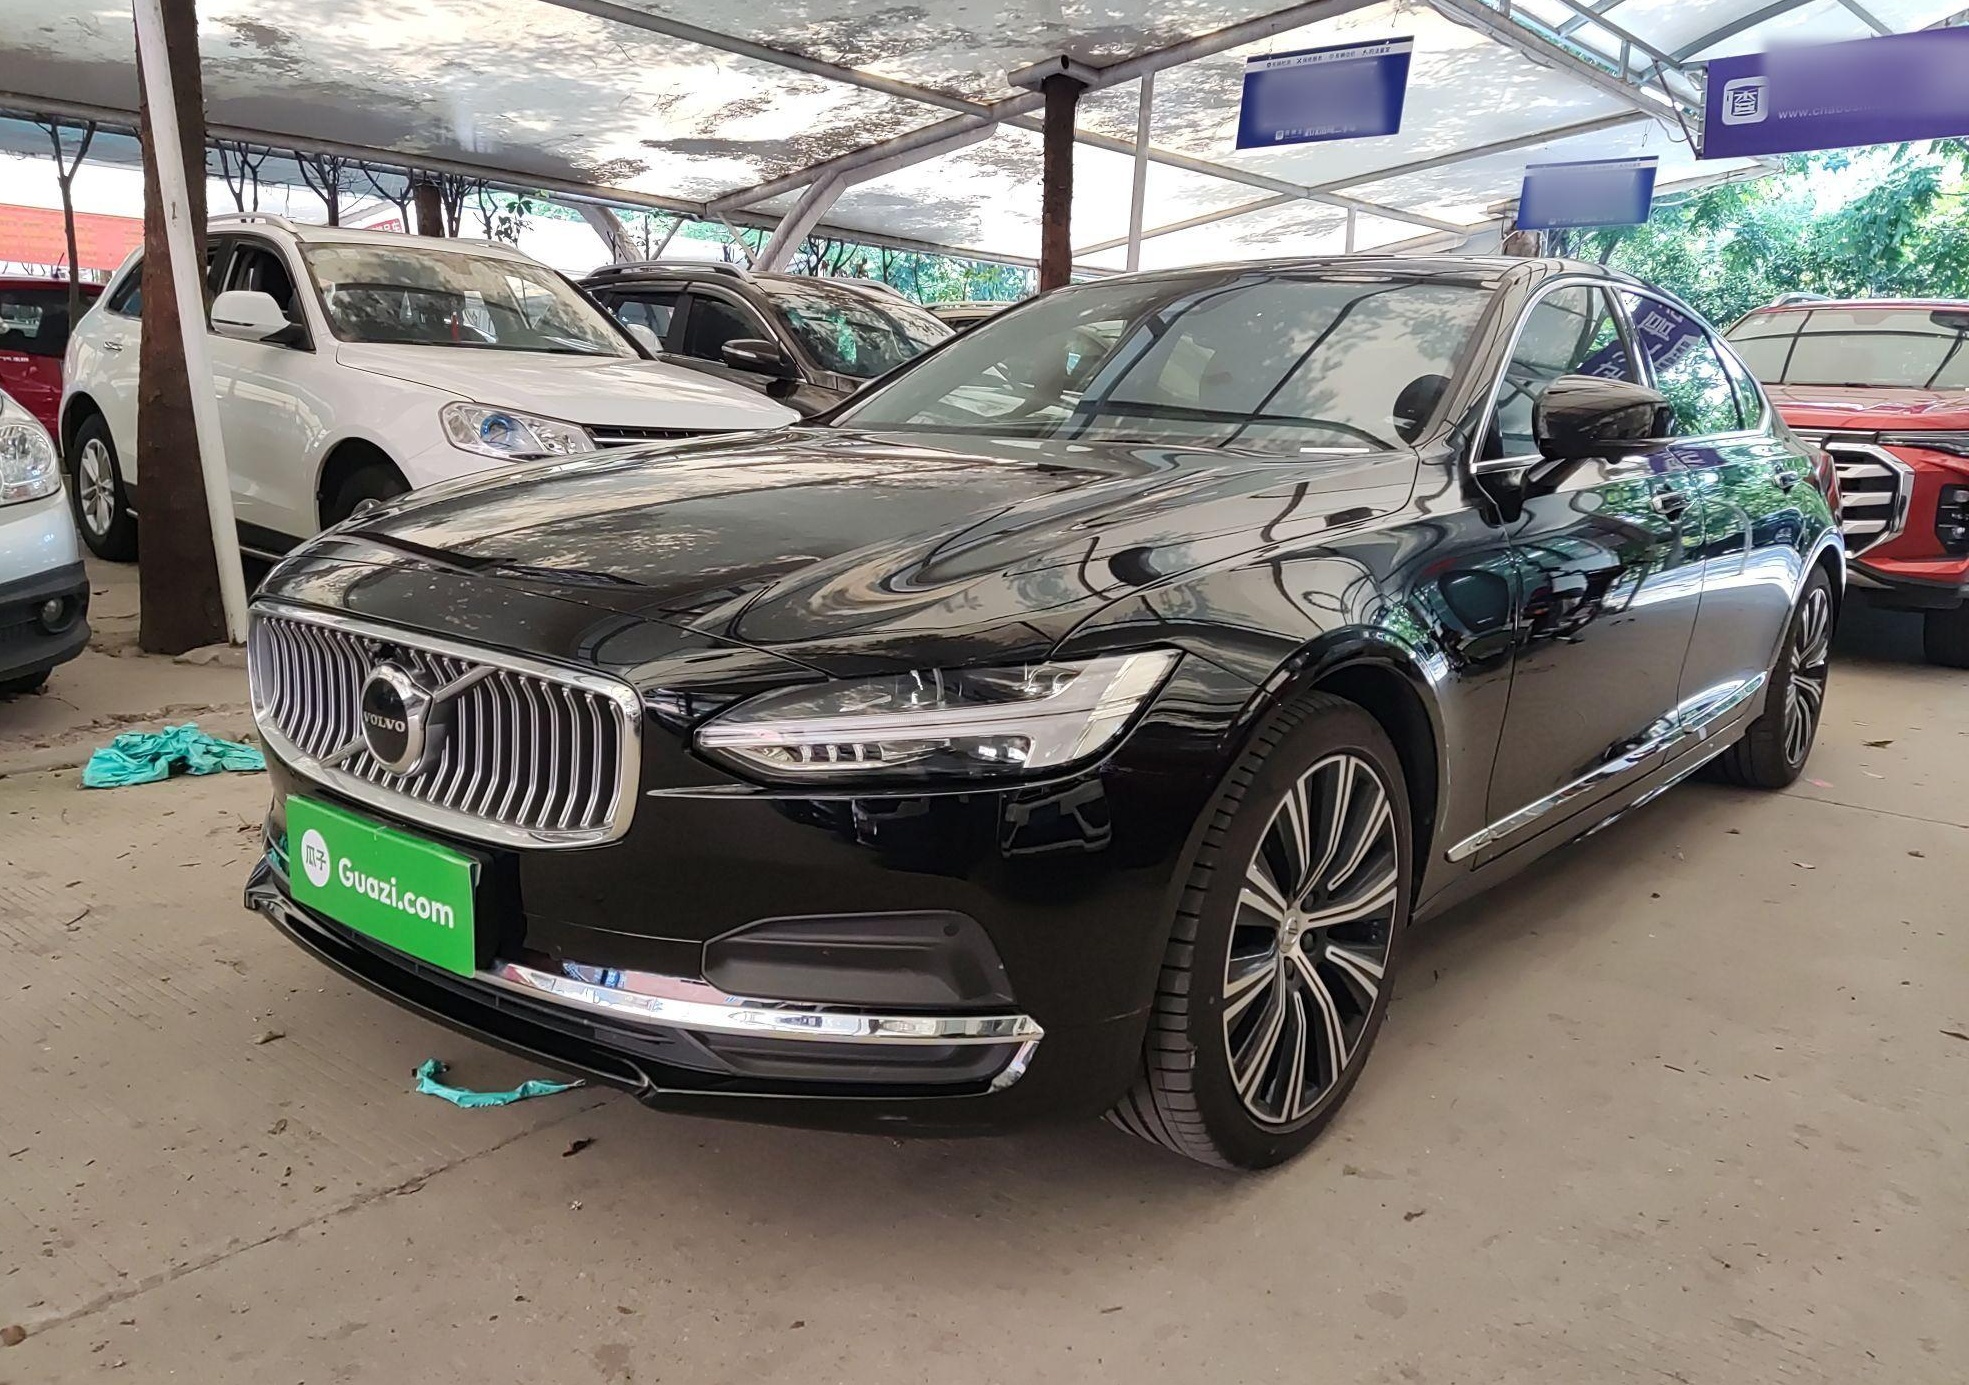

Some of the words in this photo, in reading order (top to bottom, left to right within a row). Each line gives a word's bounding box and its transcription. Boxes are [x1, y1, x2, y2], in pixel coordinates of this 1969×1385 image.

[363, 711, 406, 733] VOLVO
[305, 844, 327, 871] 瓜子
[338, 857, 455, 929] Guazi.com
